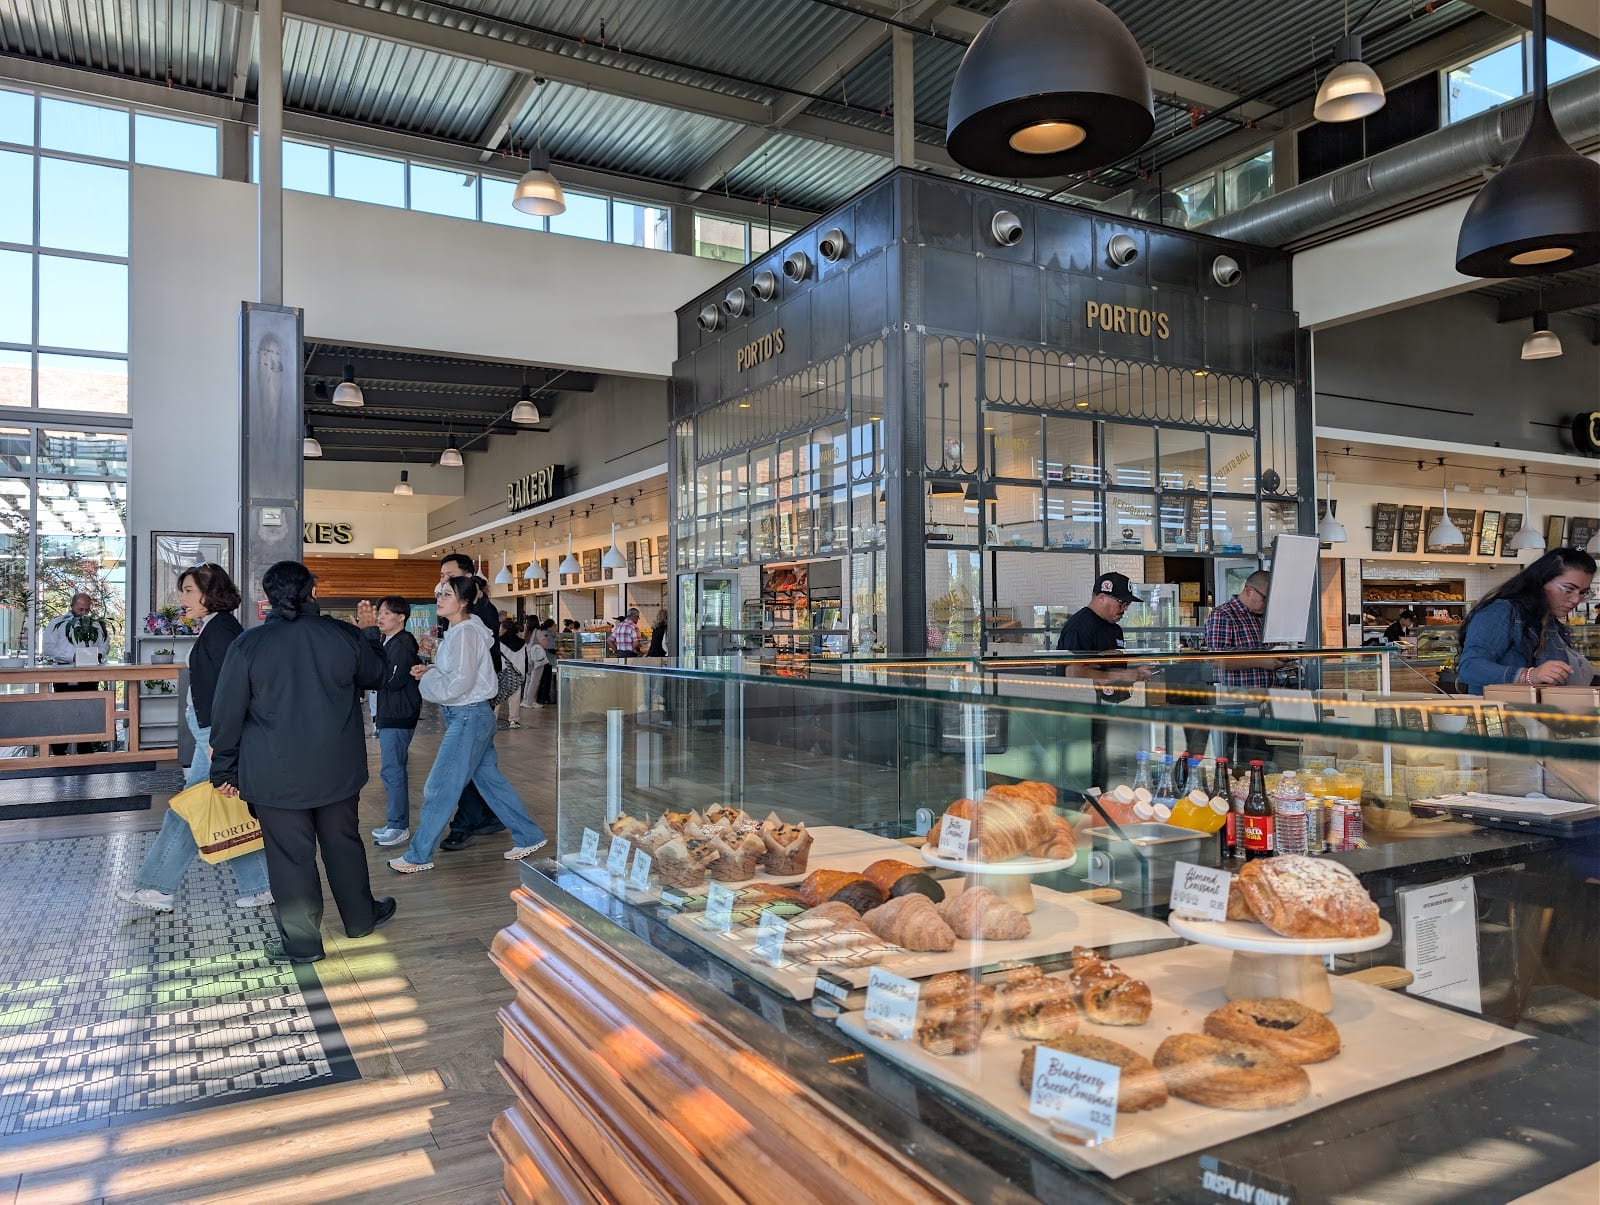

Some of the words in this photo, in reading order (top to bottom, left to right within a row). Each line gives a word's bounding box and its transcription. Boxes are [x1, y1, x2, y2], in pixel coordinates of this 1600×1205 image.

[1086, 300, 1170, 340] PORTO'S
[737, 327, 785, 373] PORTO'S
[1214, 459, 1237, 481] POTATO
[1235, 448, 1251, 465] BALL
[507, 464, 555, 511] BAKERY
[1184, 880, 1220, 896] Croissant
[1185, 867, 1218, 885] Almond
[1047, 1057, 1106, 1094] Blueberry
[1202, 1170, 1256, 1204] DISPLAY
